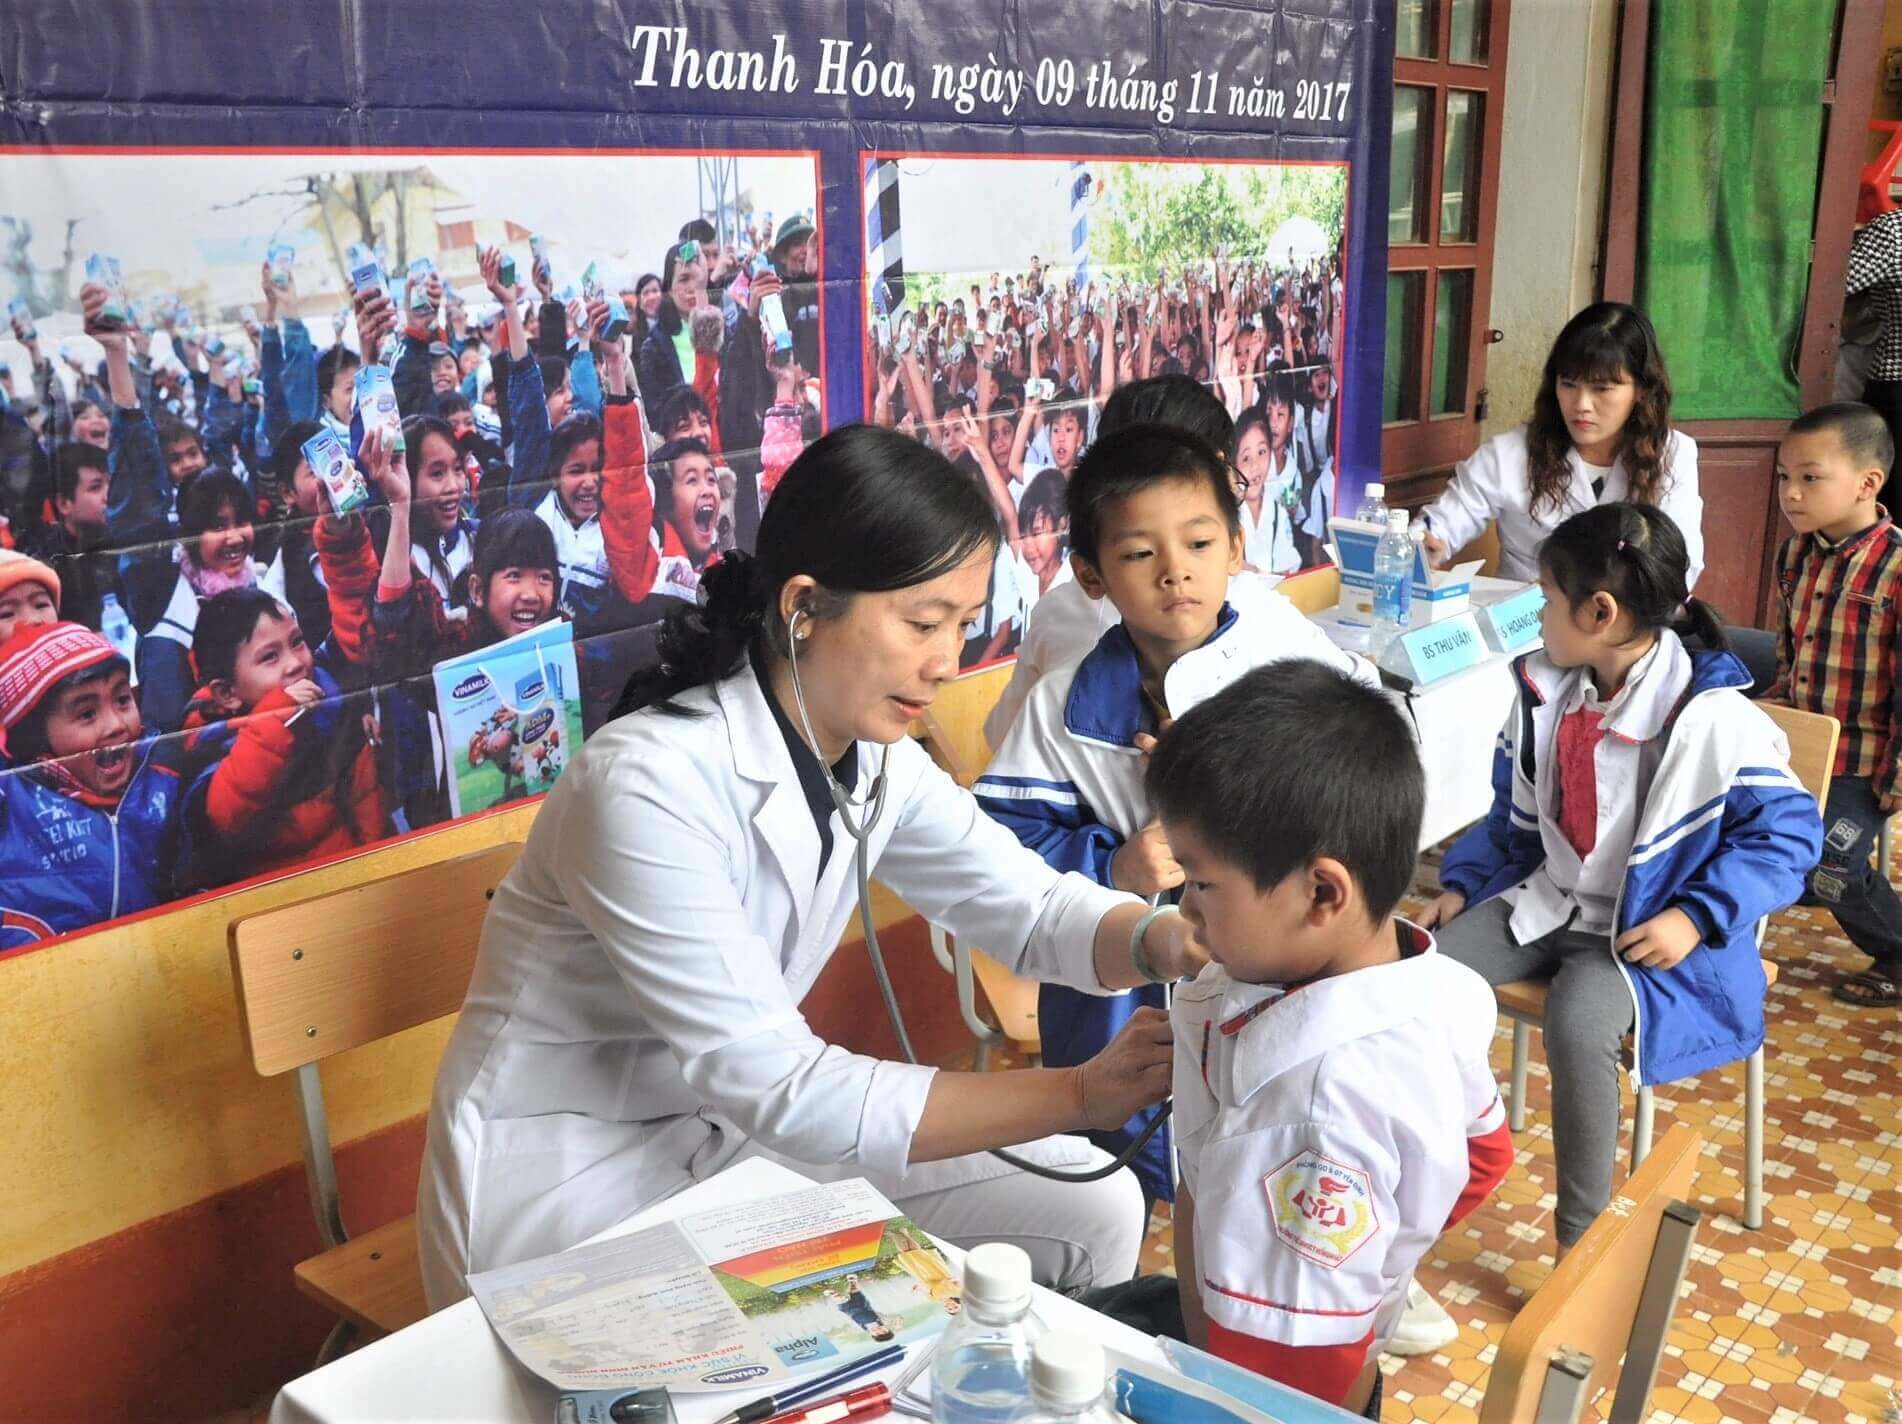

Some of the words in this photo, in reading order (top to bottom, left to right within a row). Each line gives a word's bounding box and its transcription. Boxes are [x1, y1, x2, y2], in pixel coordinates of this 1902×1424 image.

[632, 26, 800, 92] Thanh
[814, 38, 916, 110] Hóa,
[932, 52, 1023, 117] ngày
[1036, 58, 1075, 106] 09
[1087, 61, 1178, 124] tháng
[1187, 71, 1219, 114] 11
[1229, 76, 1286, 119] năm
[1293, 80, 1352, 122] 2017
[1422, 645, 1435, 660] BS
[1434, 638, 1454, 655] THU
[454, 678, 490, 697] VINAMILK
[774, 1336, 818, 1352] Alpha
[703, 1367, 766, 1383] VINAMILK
